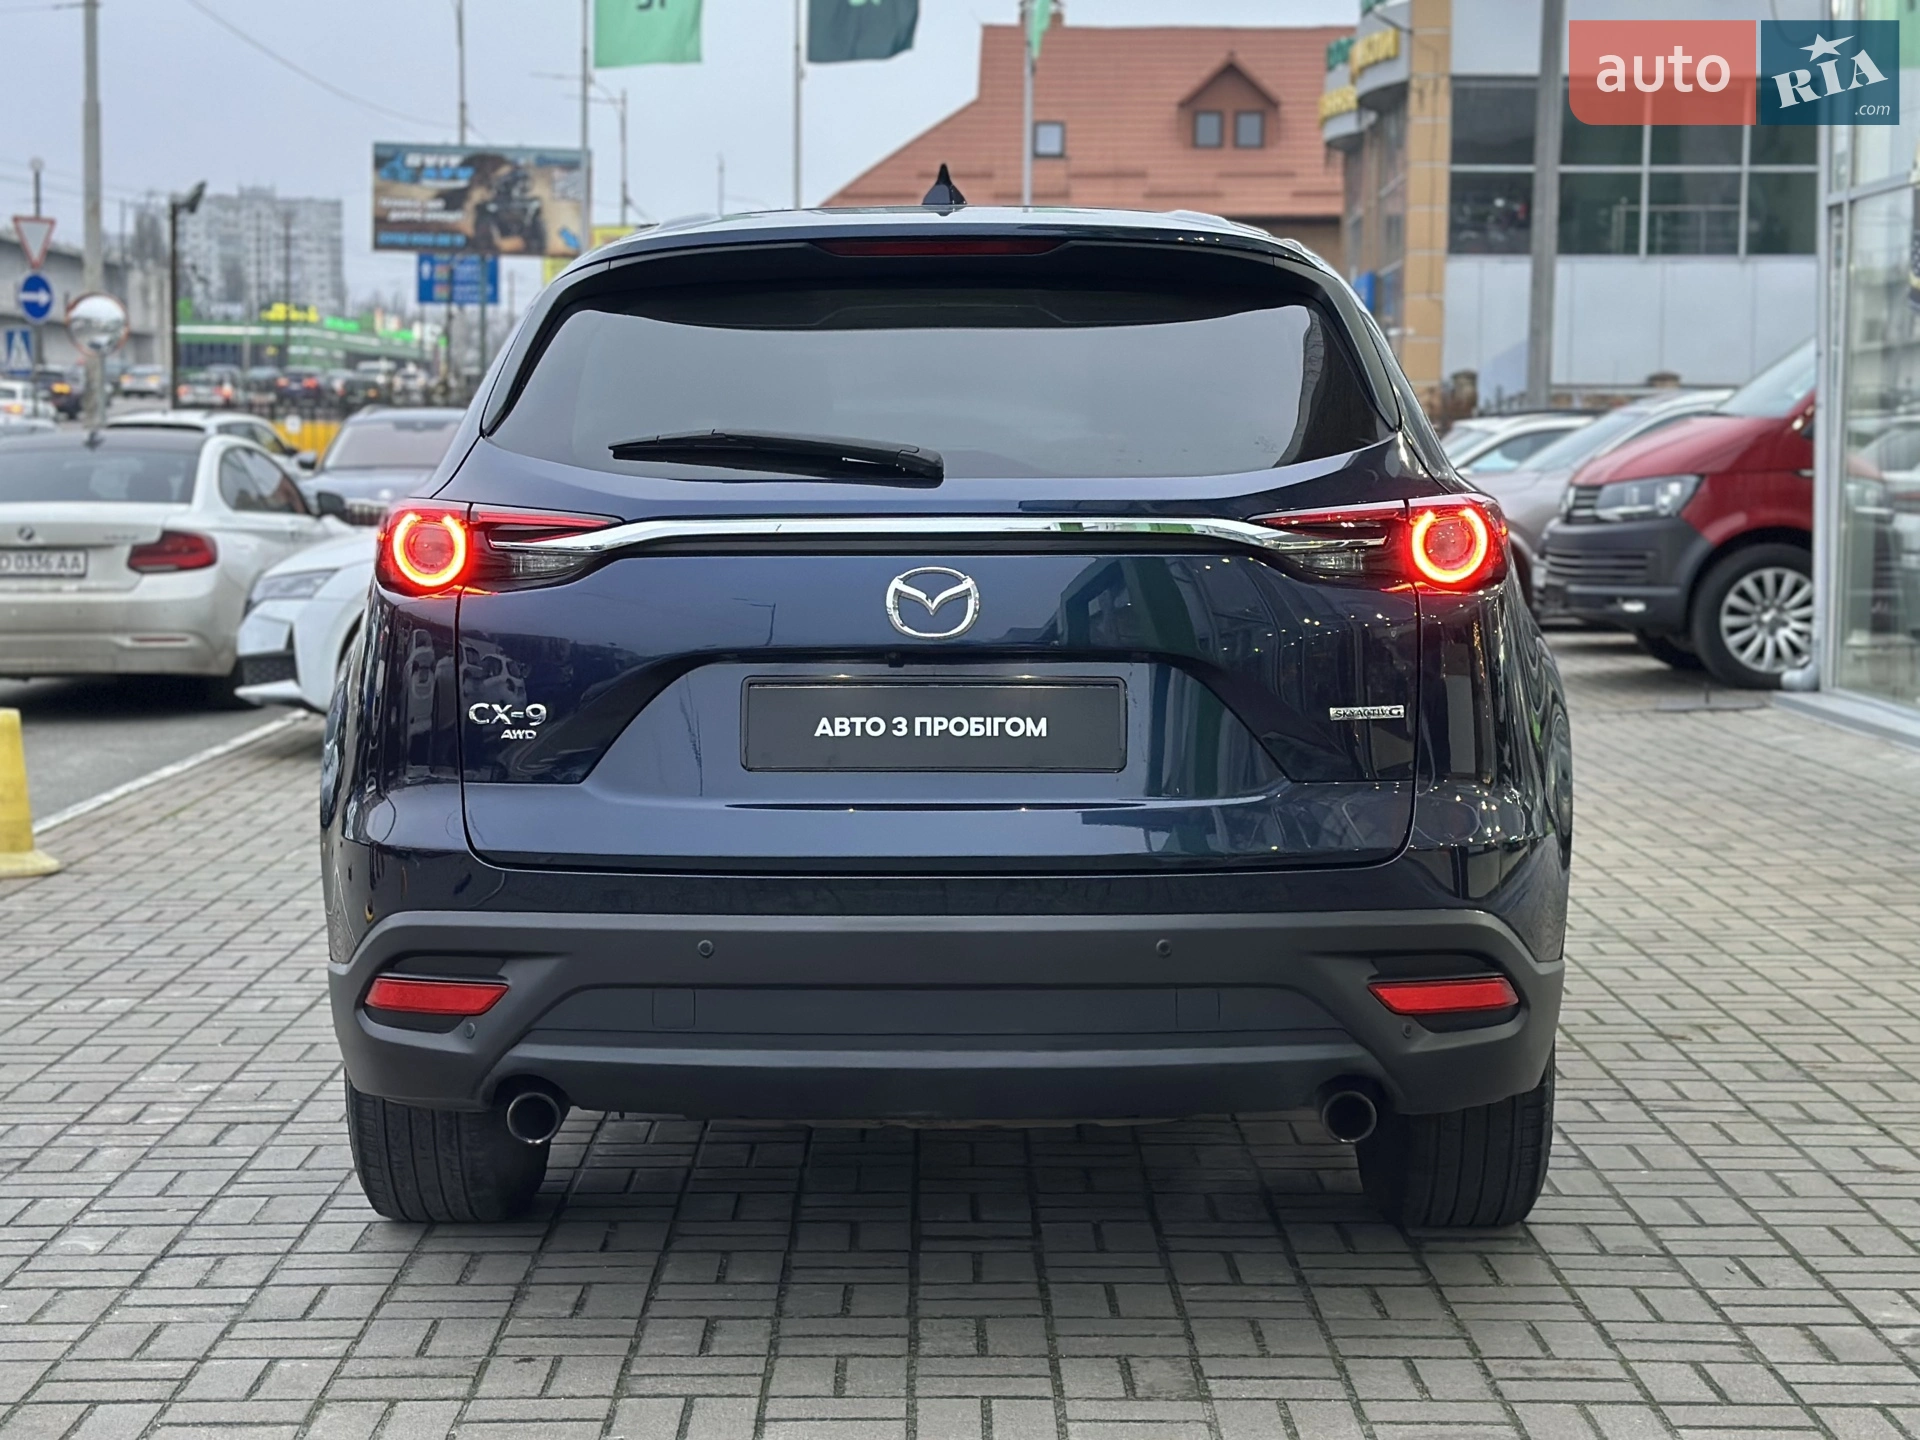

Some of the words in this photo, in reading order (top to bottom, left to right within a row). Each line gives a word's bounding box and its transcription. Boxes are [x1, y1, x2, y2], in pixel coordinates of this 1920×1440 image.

[468, 702, 547, 727] CX-9
[500, 729, 537, 741] AWD
[814, 717, 887, 737] АВТО
[914, 717, 1047, 737] ПРОБІГОМ
